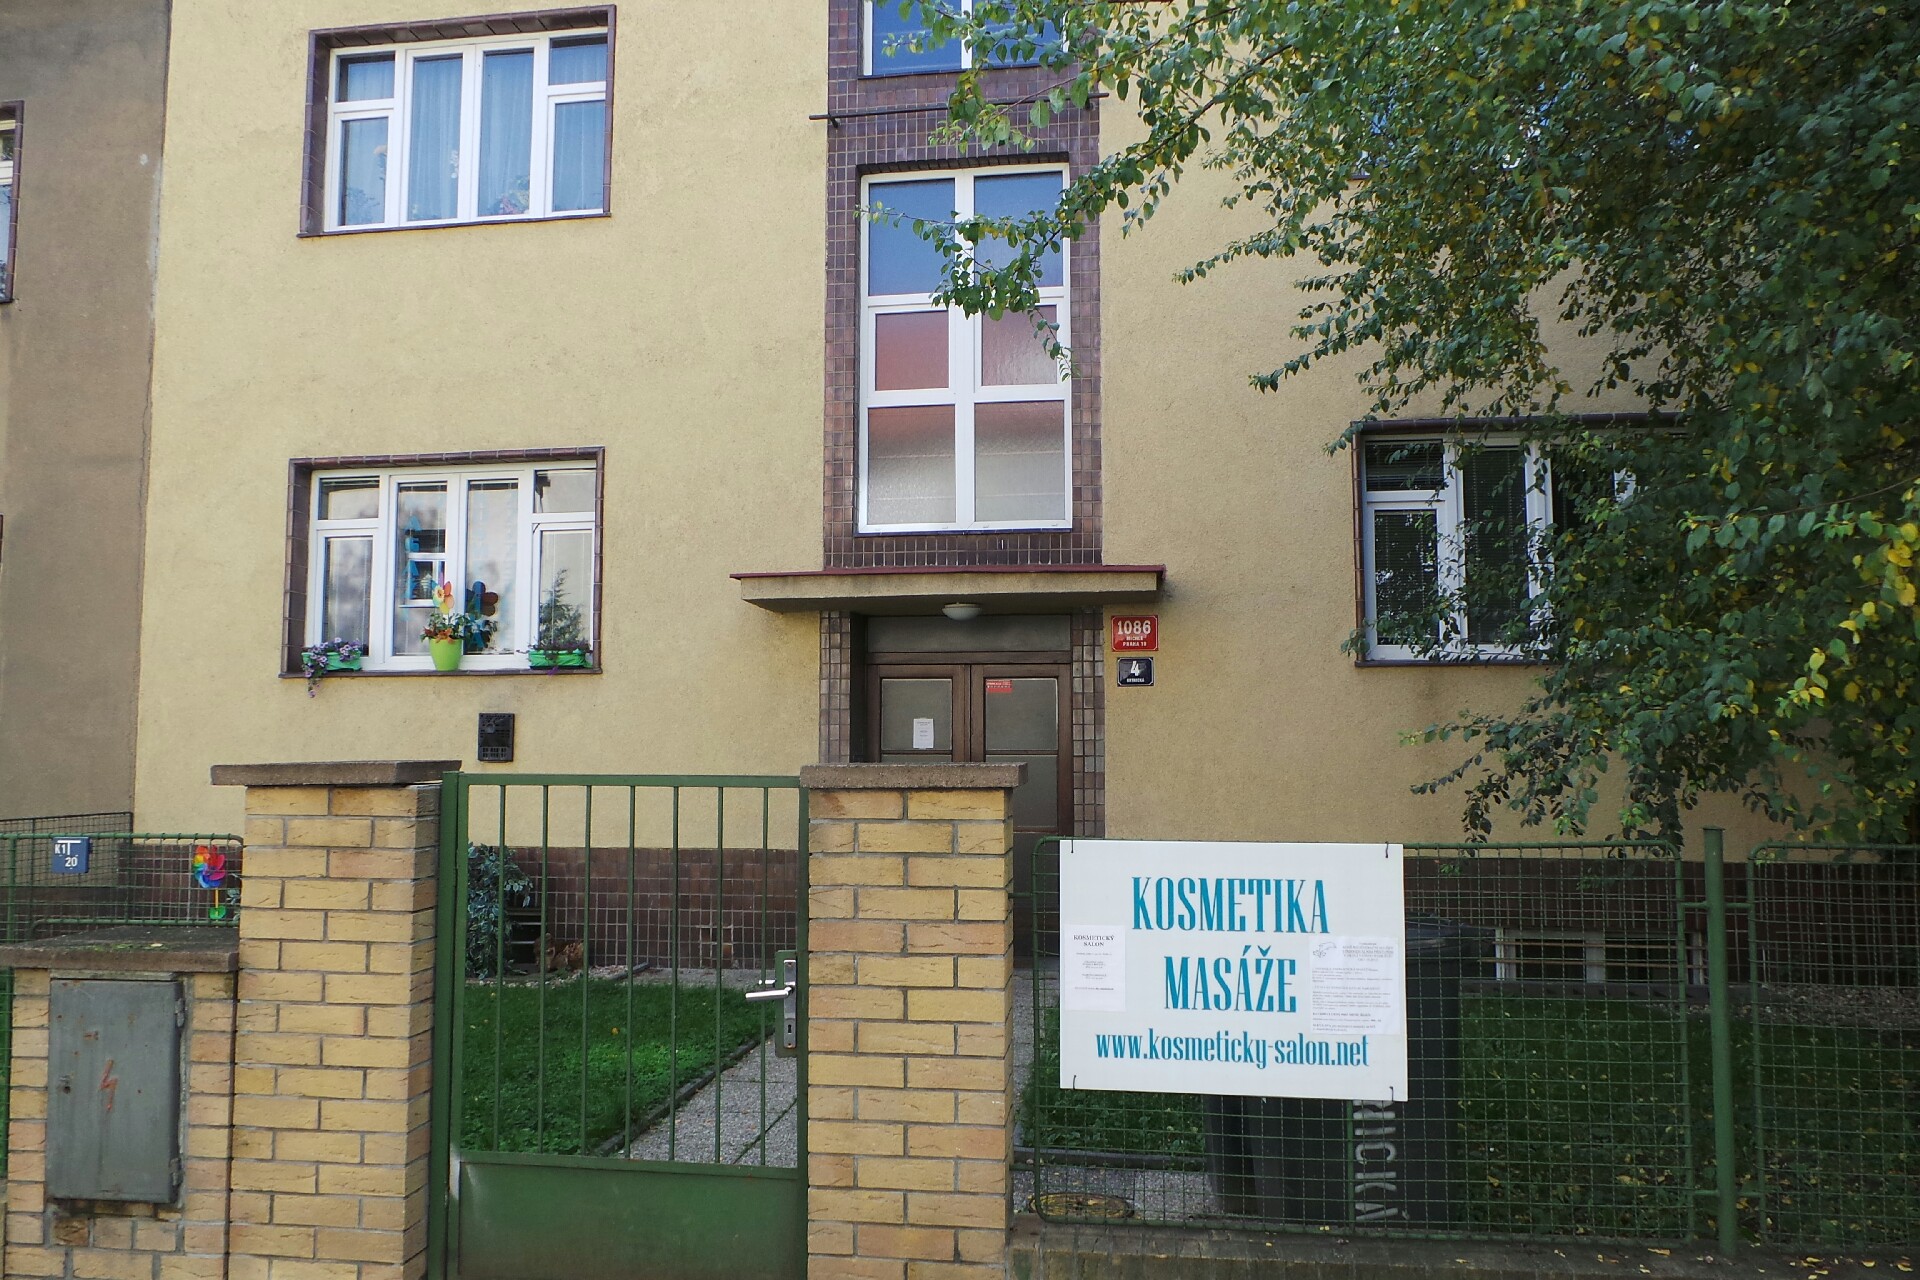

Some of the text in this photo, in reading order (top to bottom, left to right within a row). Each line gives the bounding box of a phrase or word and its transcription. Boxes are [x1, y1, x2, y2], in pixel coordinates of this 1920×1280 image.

[1117, 620, 1151, 635] 1086
[1130, 660, 1140, 677] 4
[54, 843, 66, 854] K1
[64, 856, 78, 867] 20
[1132, 876, 1329, 934] KOSMETIKA
[1164, 944, 1298, 1013] MASÁŽE
[1096, 1028, 1369, 1068] www.kosmeticky-salon.net
